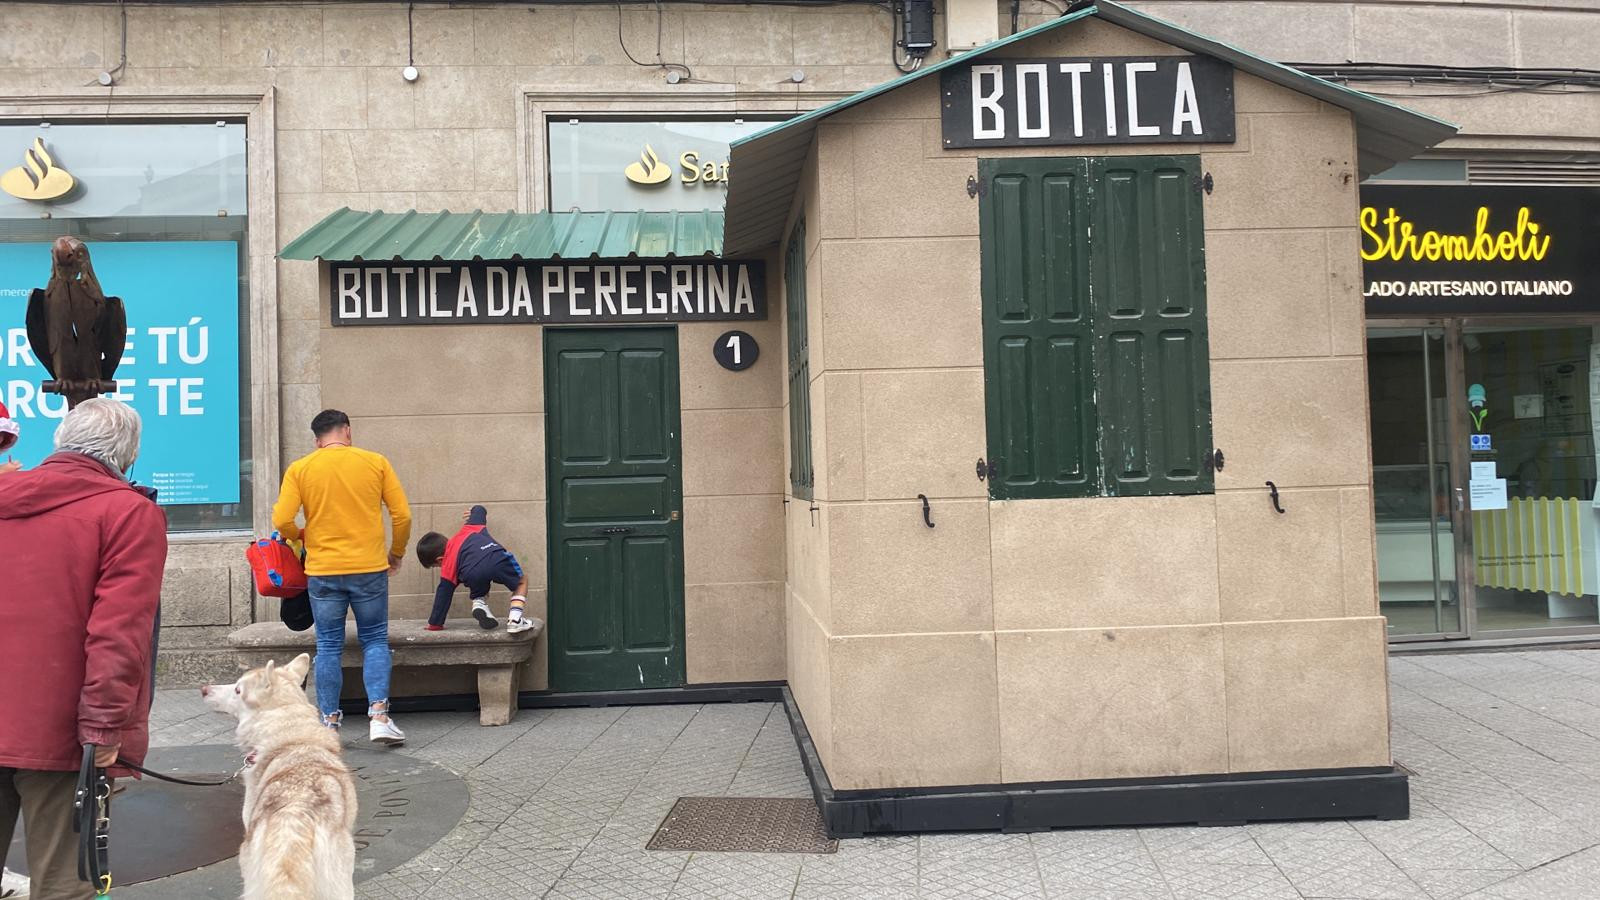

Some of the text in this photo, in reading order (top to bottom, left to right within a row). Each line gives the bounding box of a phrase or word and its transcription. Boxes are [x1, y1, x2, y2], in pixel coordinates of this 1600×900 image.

[971, 62, 1203, 140] BOTICA
[1359, 205, 1551, 261] Stromboli
[337, 264, 756, 319] BOTICA DA PEREGRINA
[1408, 280, 1497, 297] ARTESANO
[1501, 280, 1573, 296] ITALIANO
[148, 316, 209, 365] TÚ
[726, 336, 741, 365] 1
[148, 377, 205, 416] TE
